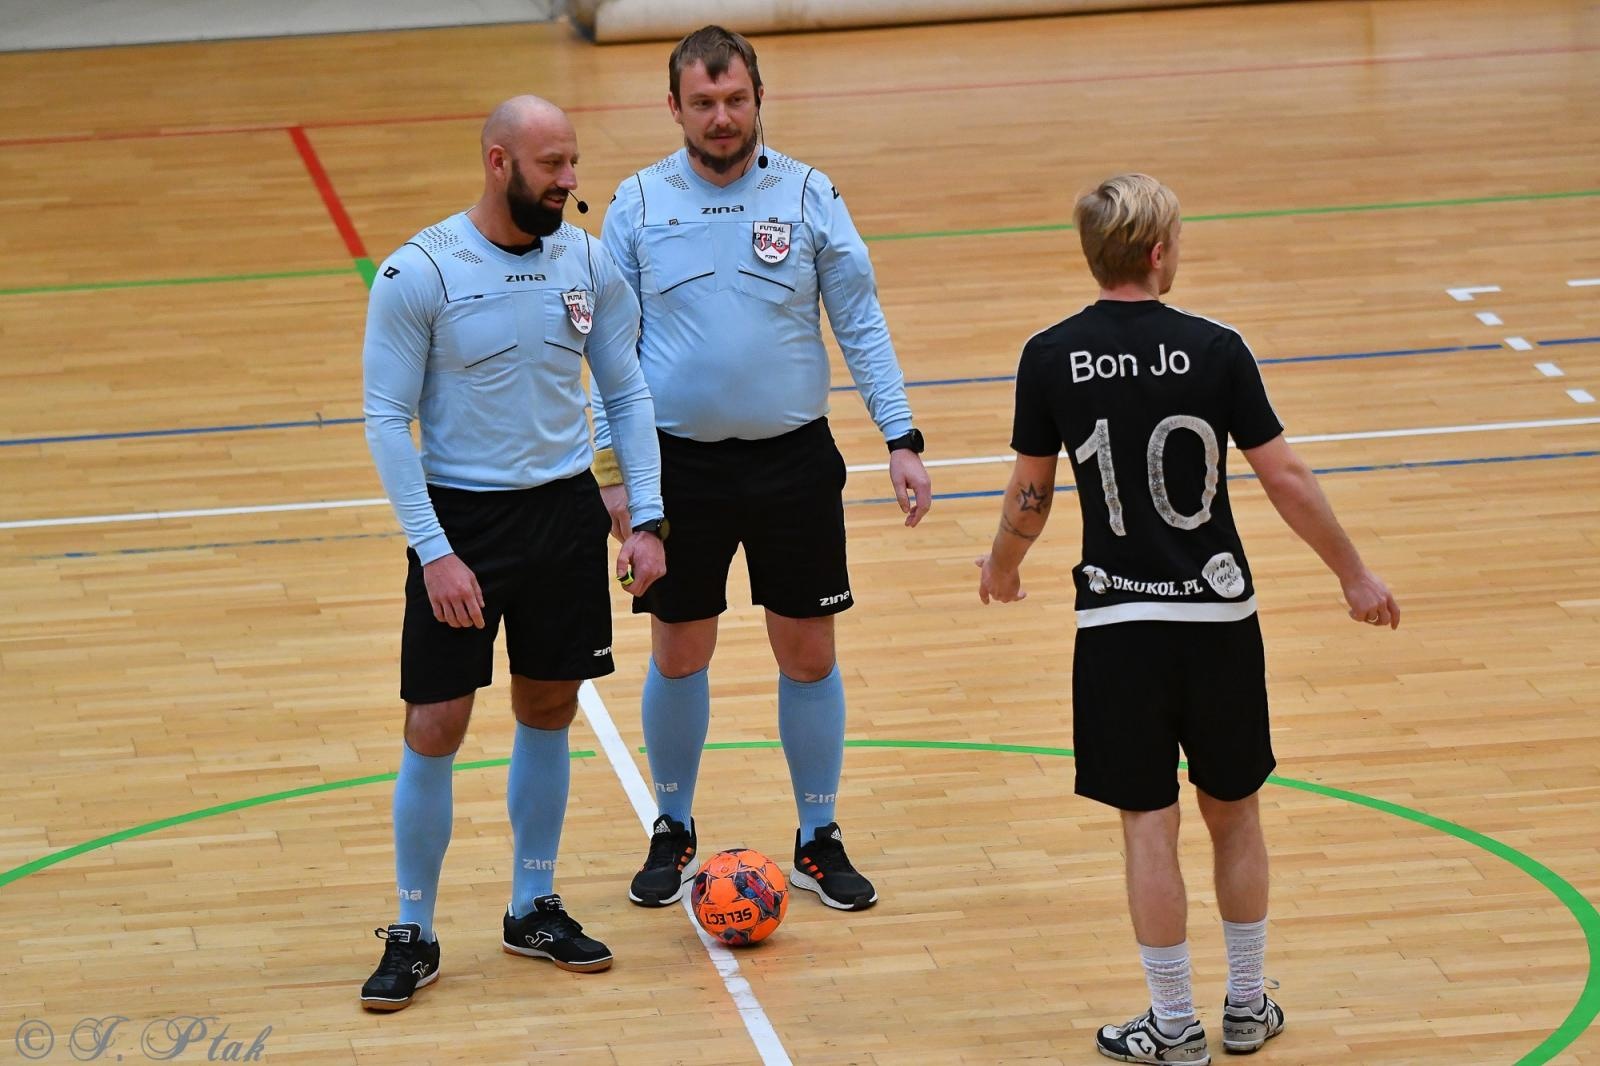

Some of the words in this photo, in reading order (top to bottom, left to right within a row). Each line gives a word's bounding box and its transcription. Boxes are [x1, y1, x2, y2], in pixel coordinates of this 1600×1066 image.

[759, 225, 786, 233] FUTSAL
[1070, 349, 1139, 383] Bon
[1150, 344, 1191, 376] Jo
[1075, 414, 1219, 537] 10
[593, 646, 611, 657] zin
[655, 782, 678, 793] na
[804, 792, 836, 804] zin
[522, 857, 557, 871] zin
[704, 907, 753, 925] SELECT
